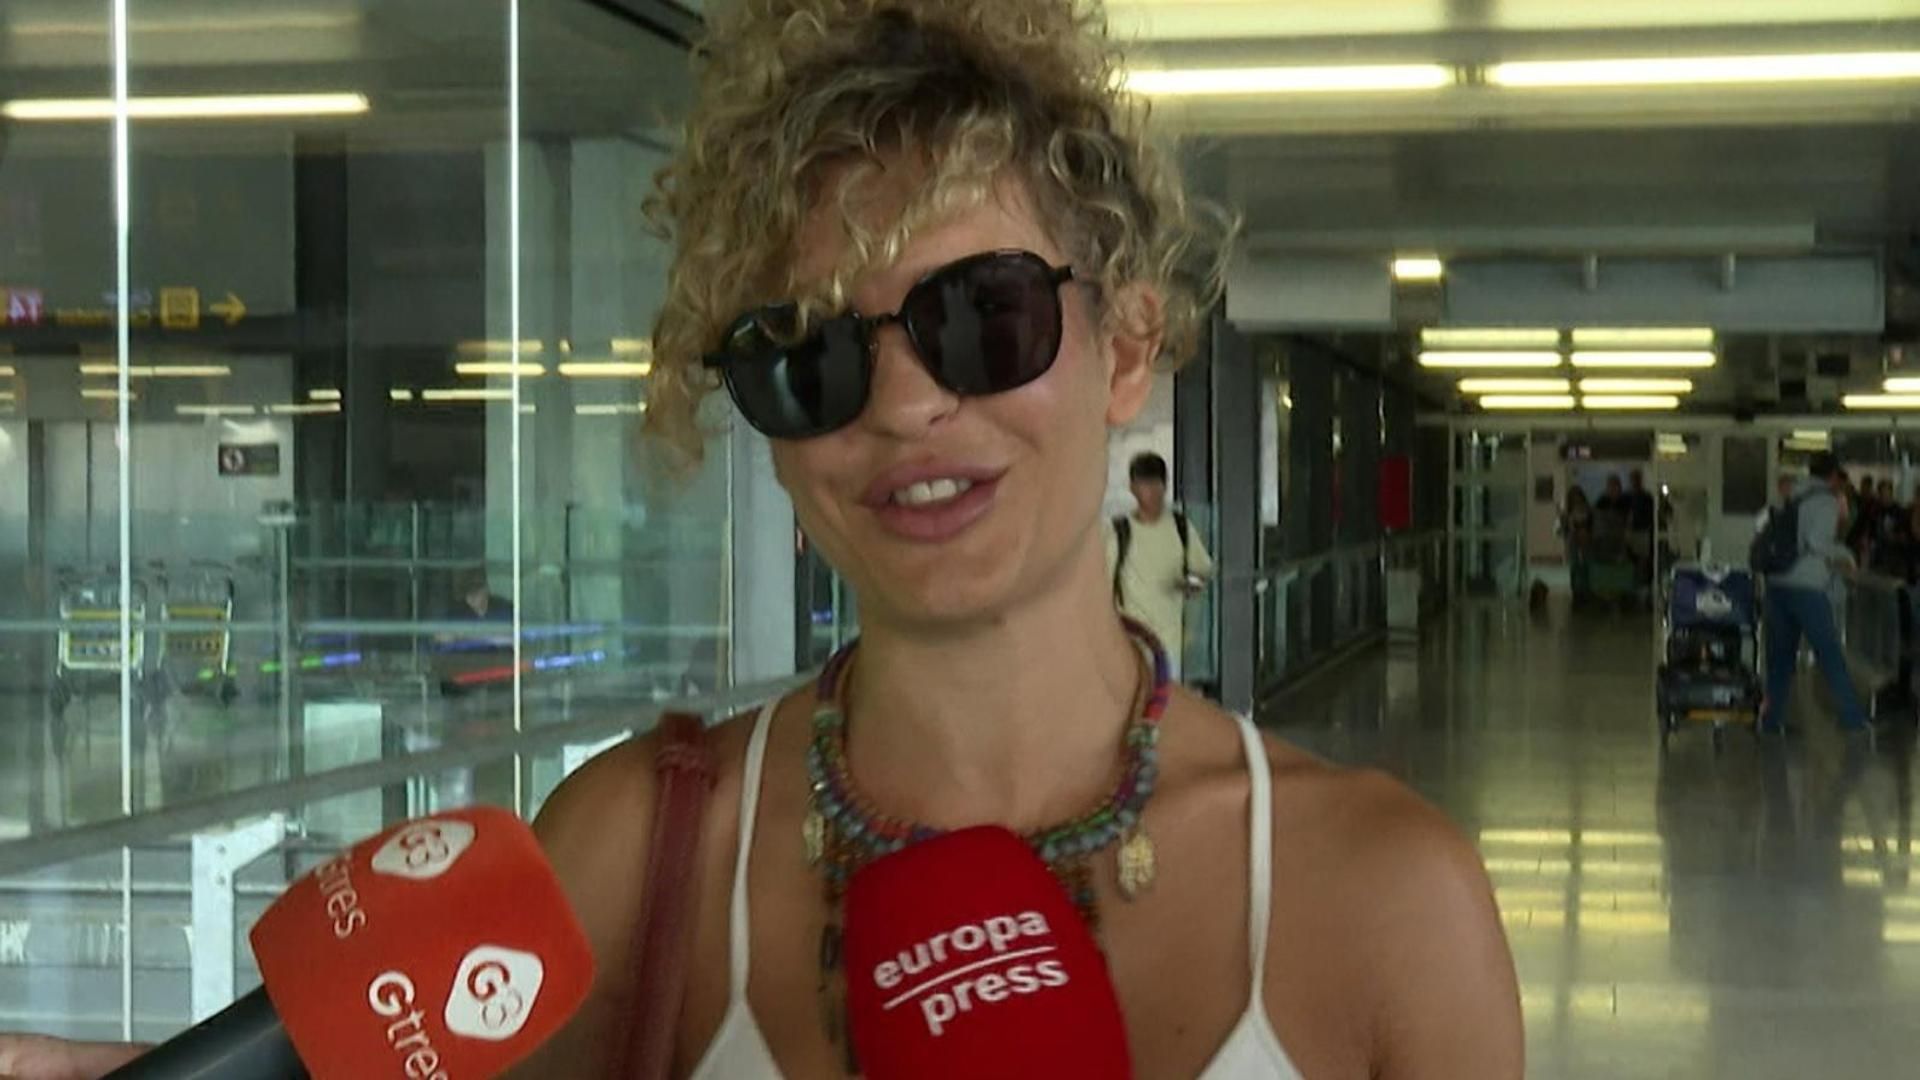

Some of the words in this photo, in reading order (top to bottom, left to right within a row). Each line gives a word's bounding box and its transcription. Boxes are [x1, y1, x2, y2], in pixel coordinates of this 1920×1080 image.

[873, 911, 1050, 989] europa
[368, 970, 448, 1080] Gtre
[920, 960, 1069, 1036] press
